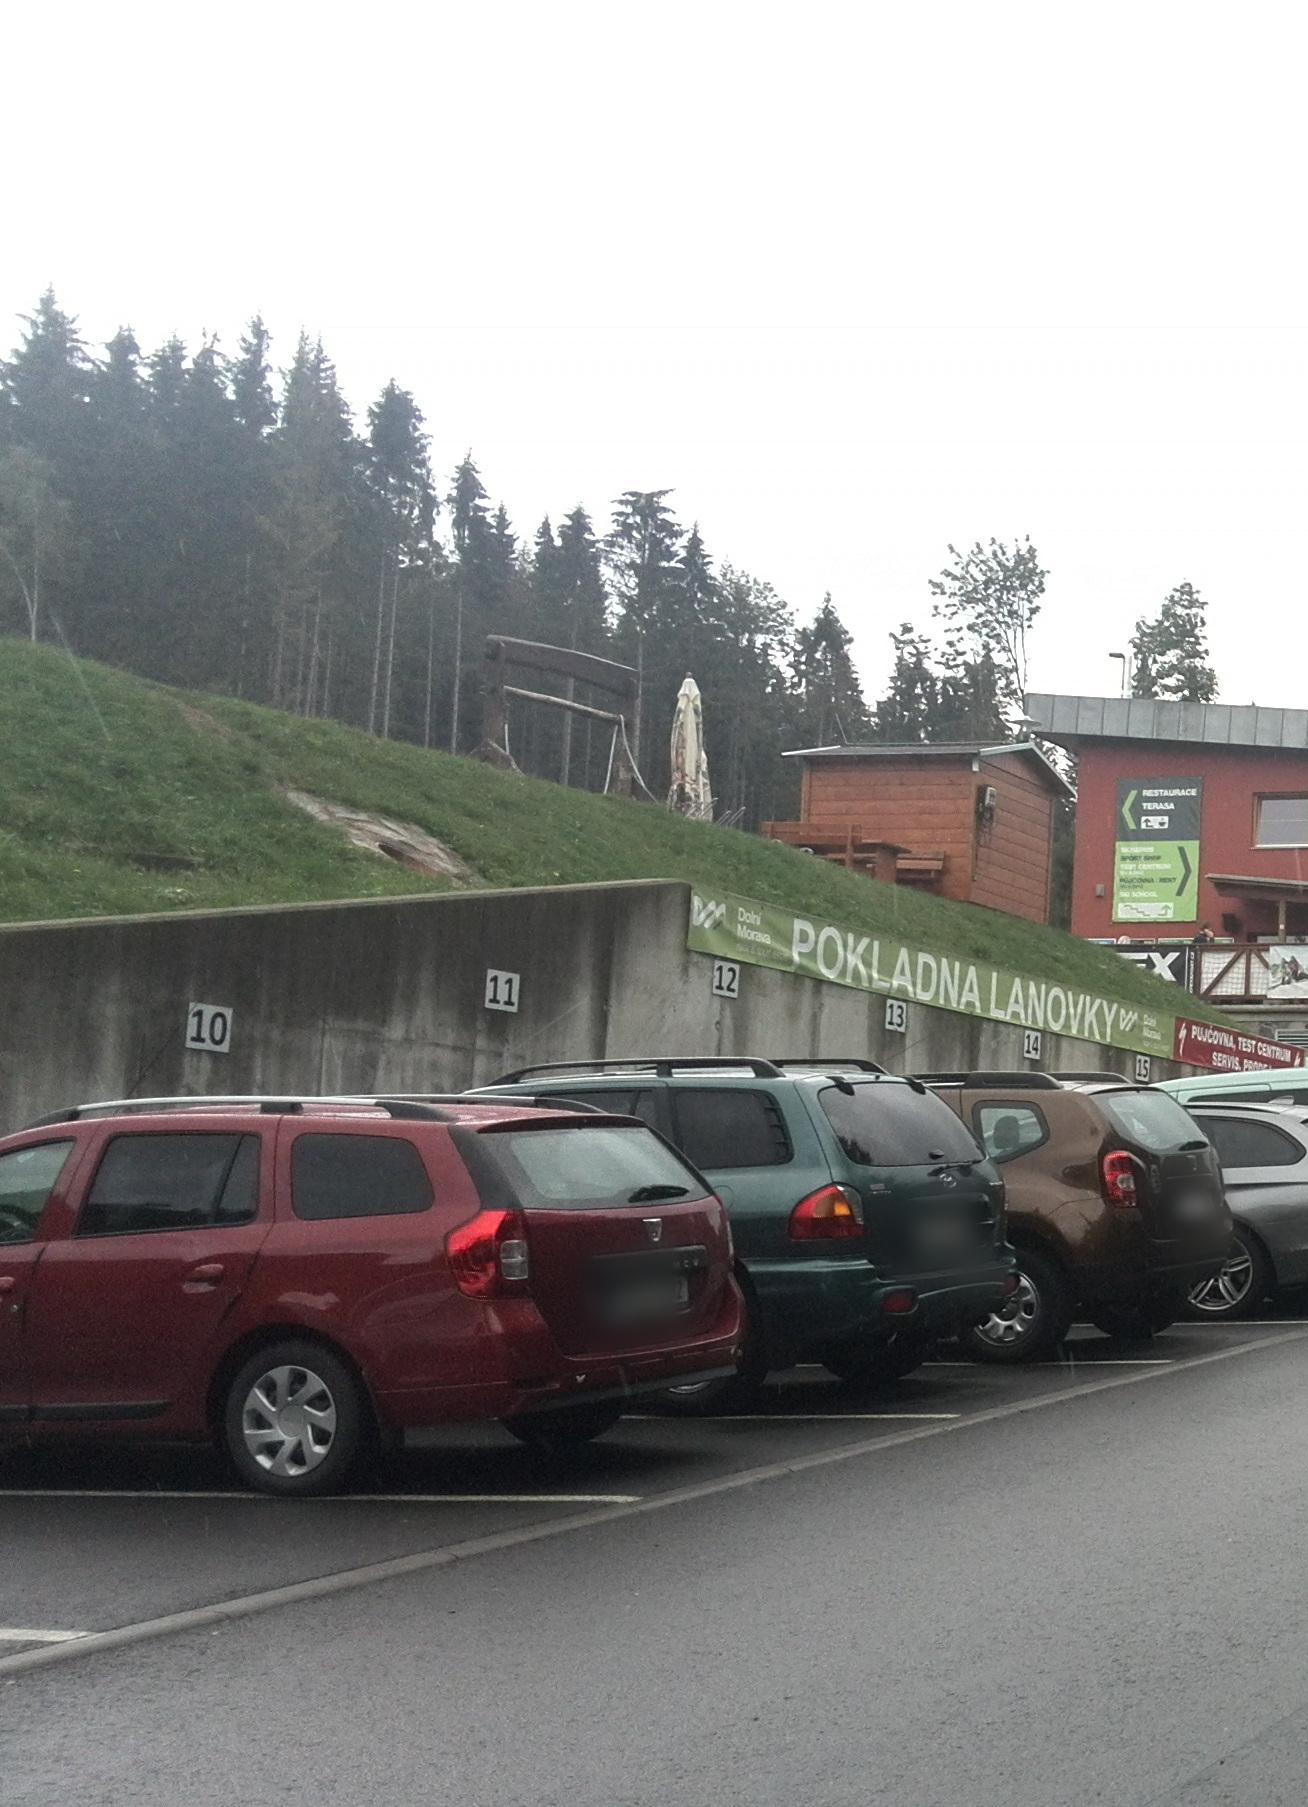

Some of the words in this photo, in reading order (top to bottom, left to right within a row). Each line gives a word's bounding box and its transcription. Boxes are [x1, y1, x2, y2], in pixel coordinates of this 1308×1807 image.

[1142, 788, 1198, 797] RESTAURACE
[1142, 802, 1175, 810] TERASA
[738, 907, 762, 925] Dolní
[737, 923, 771, 945] Morava
[715, 965, 737, 993] 12
[792, 918, 981, 1013] POKLADNA
[990, 972, 1118, 1042] LANOVKY
[488, 975, 515, 1007] 11
[887, 1001, 904, 1028] 13
[190, 1009, 228, 1046] 10
[1024, 1033, 1039, 1053] 14
[1238, 1037, 1256, 1053] TEST
[1257, 1042, 1291, 1062] CENTRUM
[1136, 1056, 1149, 1078] 15
